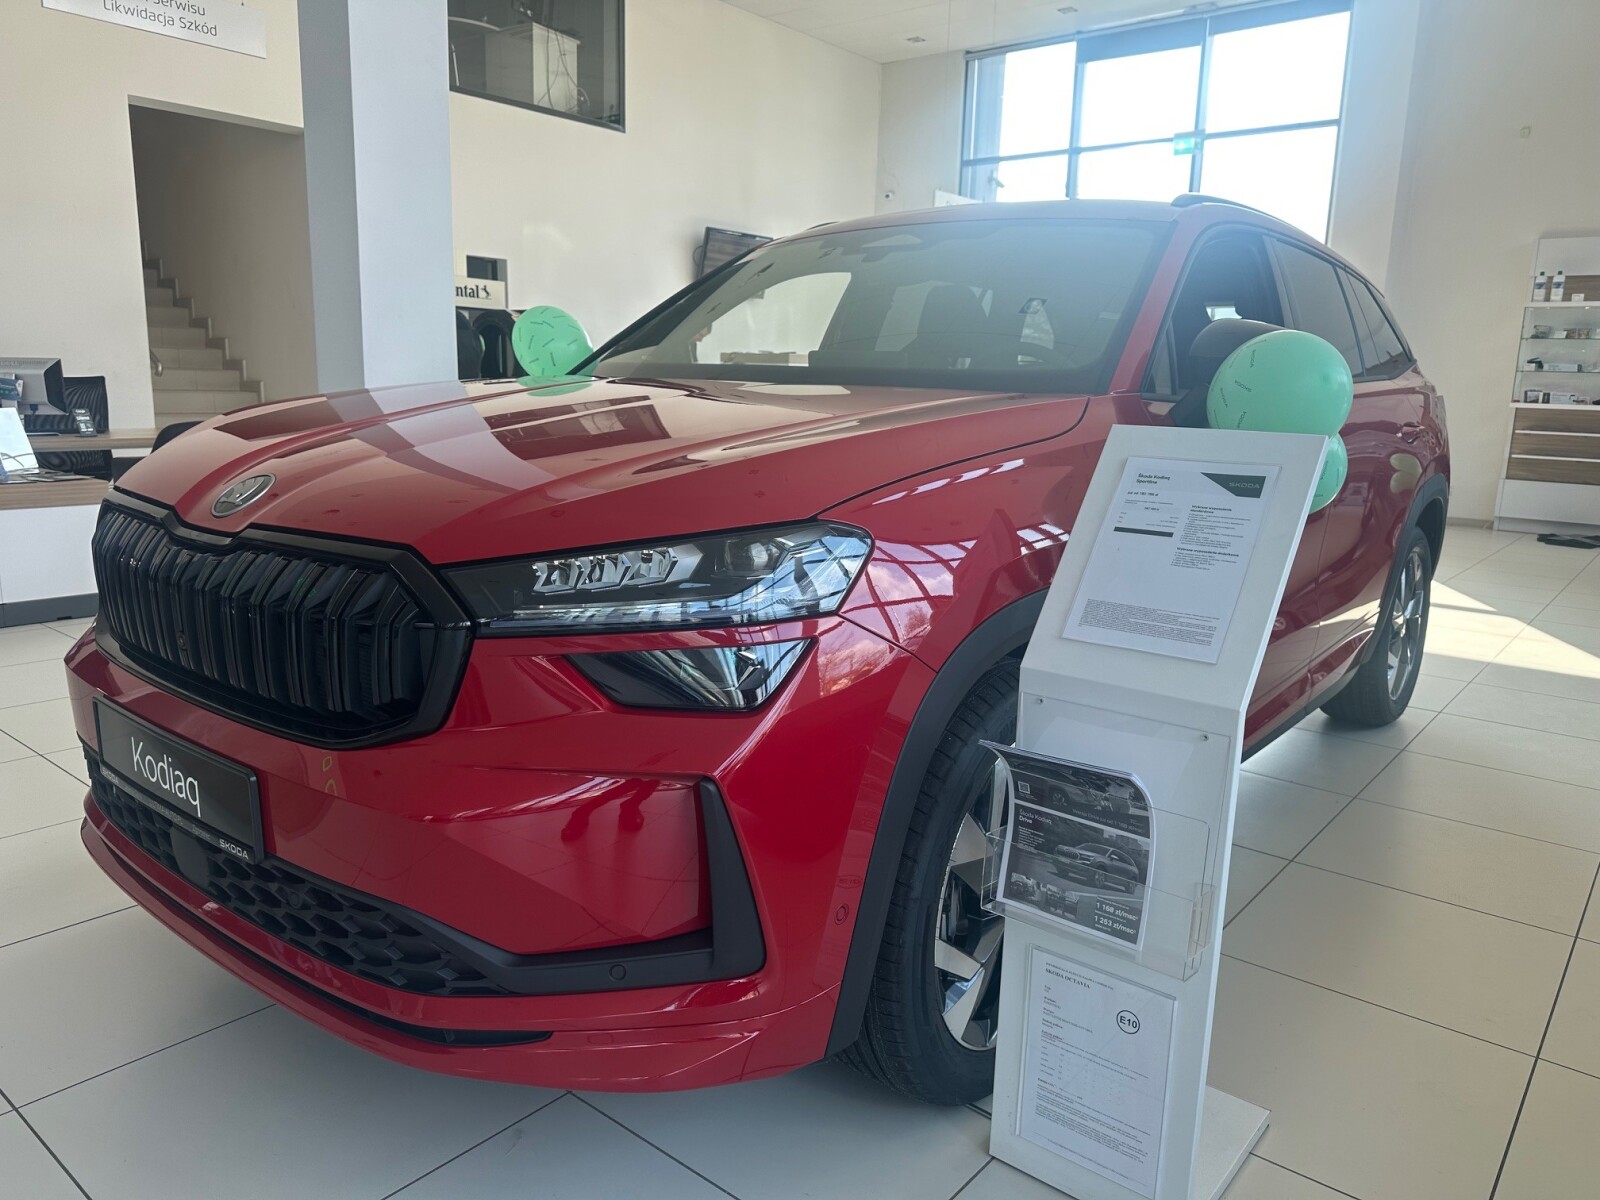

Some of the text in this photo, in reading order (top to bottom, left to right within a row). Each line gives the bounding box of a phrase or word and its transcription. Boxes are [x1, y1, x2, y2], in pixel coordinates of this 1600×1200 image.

[103, 0, 218, 37] Likwidacja Szkód
[131, 736, 202, 818] Kodiaq
[1119, 1015, 1138, 1029] E10
